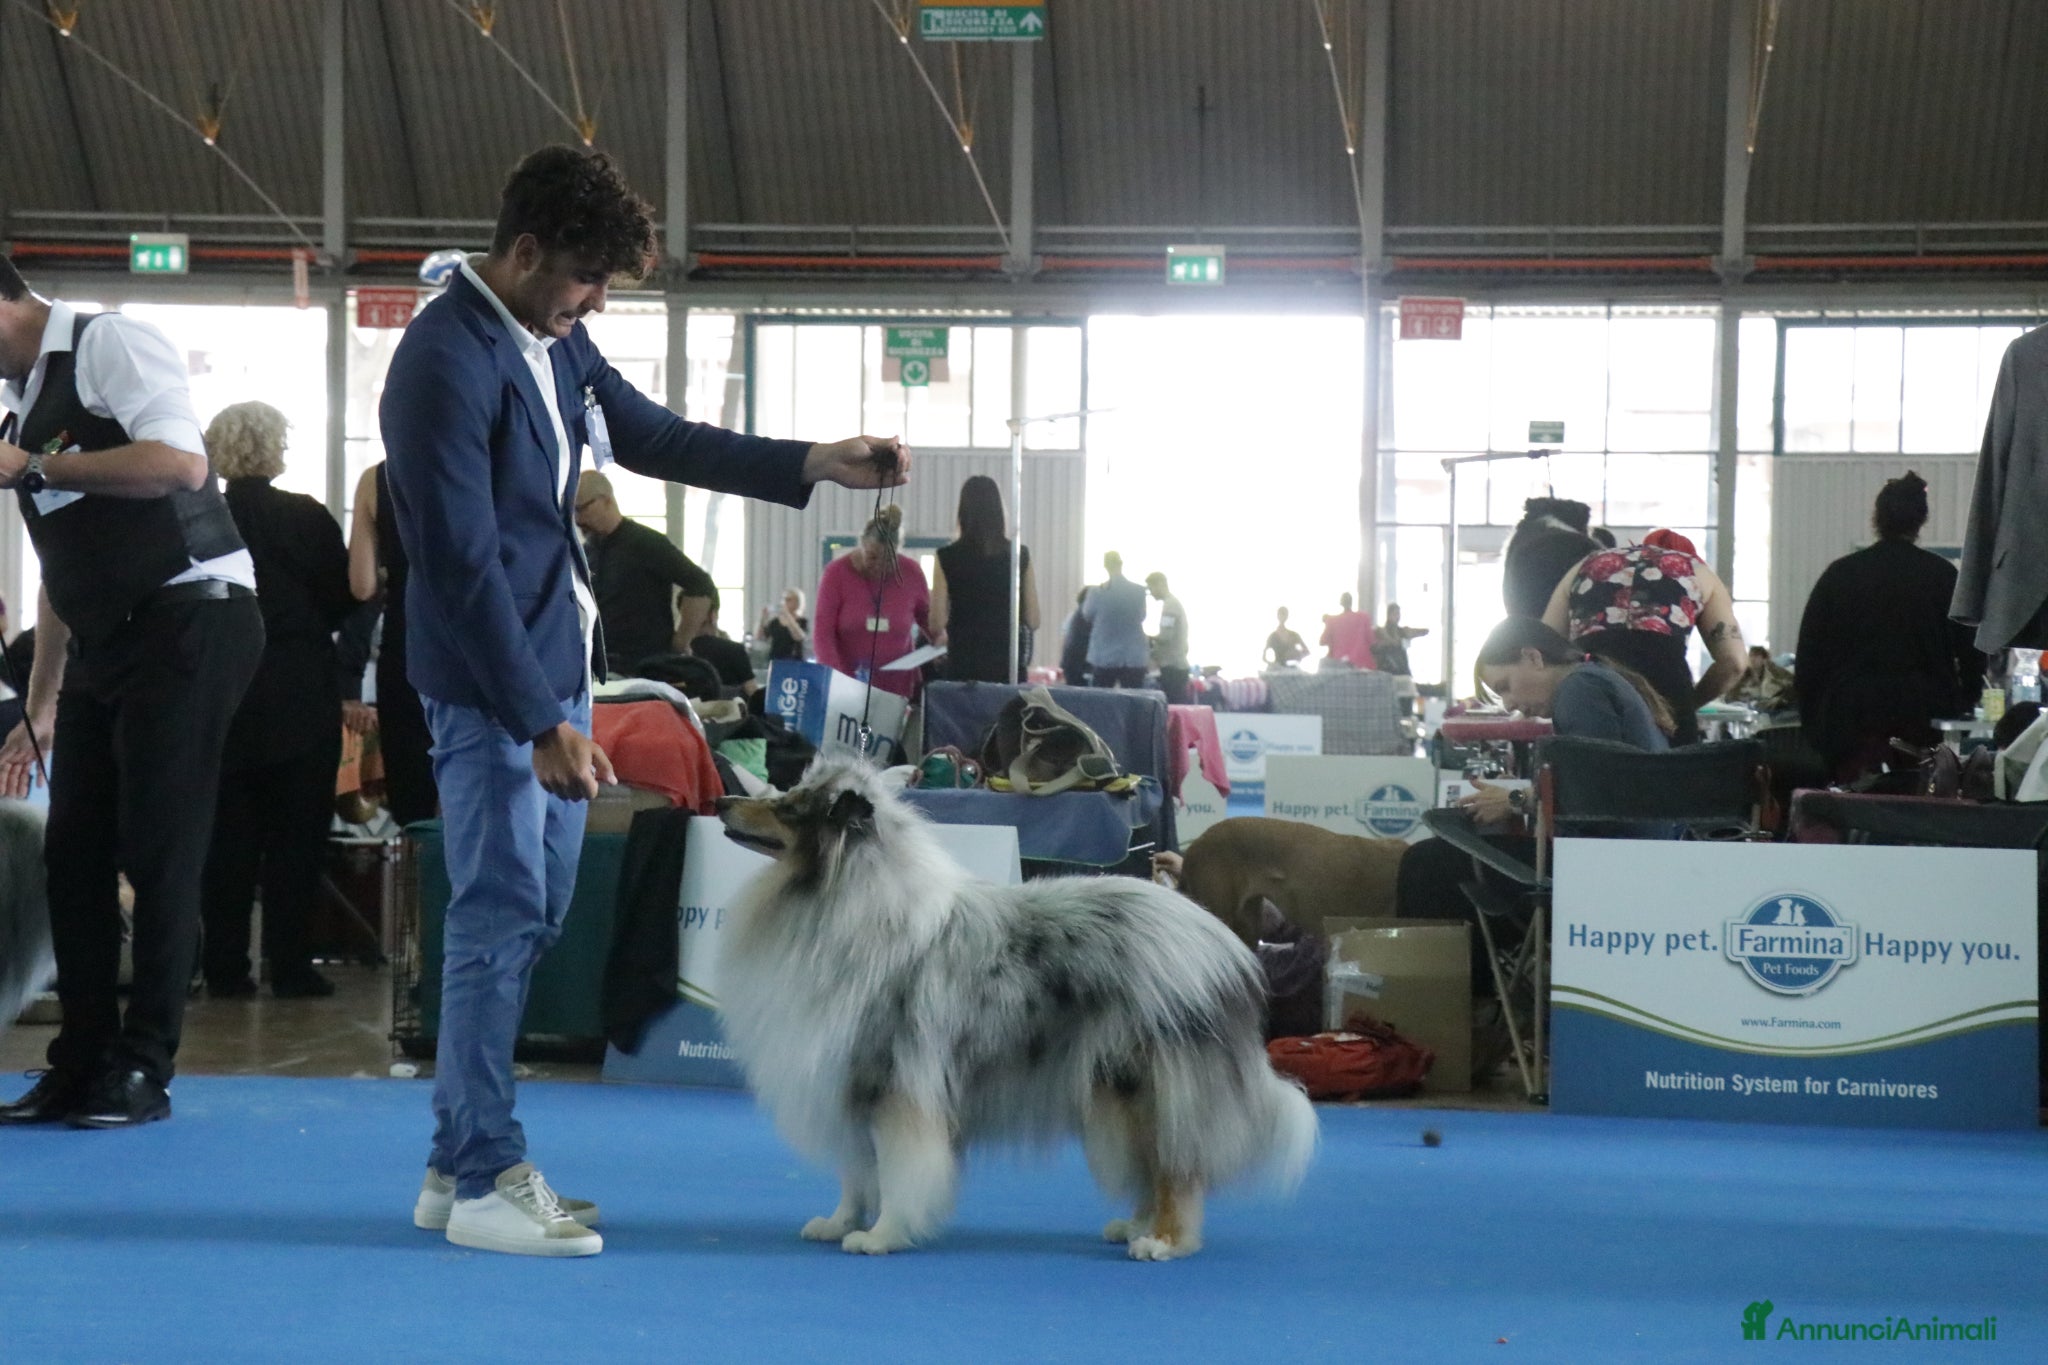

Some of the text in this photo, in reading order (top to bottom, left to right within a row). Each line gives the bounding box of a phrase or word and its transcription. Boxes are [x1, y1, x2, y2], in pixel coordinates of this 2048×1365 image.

[1186, 803, 1216, 816] you.
[1272, 801, 1318, 817] Happy
[1363, 803, 1420, 817] Farmina
[1568, 923, 1719, 957] Happy pet.
[1739, 928, 1844, 956] Farmina
[1865, 932, 2021, 966] Happy you.
[1762, 962, 1820, 976] Pet Foods
[1740, 1017, 1842, 1031] www.Farmina.com
[1645, 1071, 1938, 1099] Nutrition System for Carnivores
